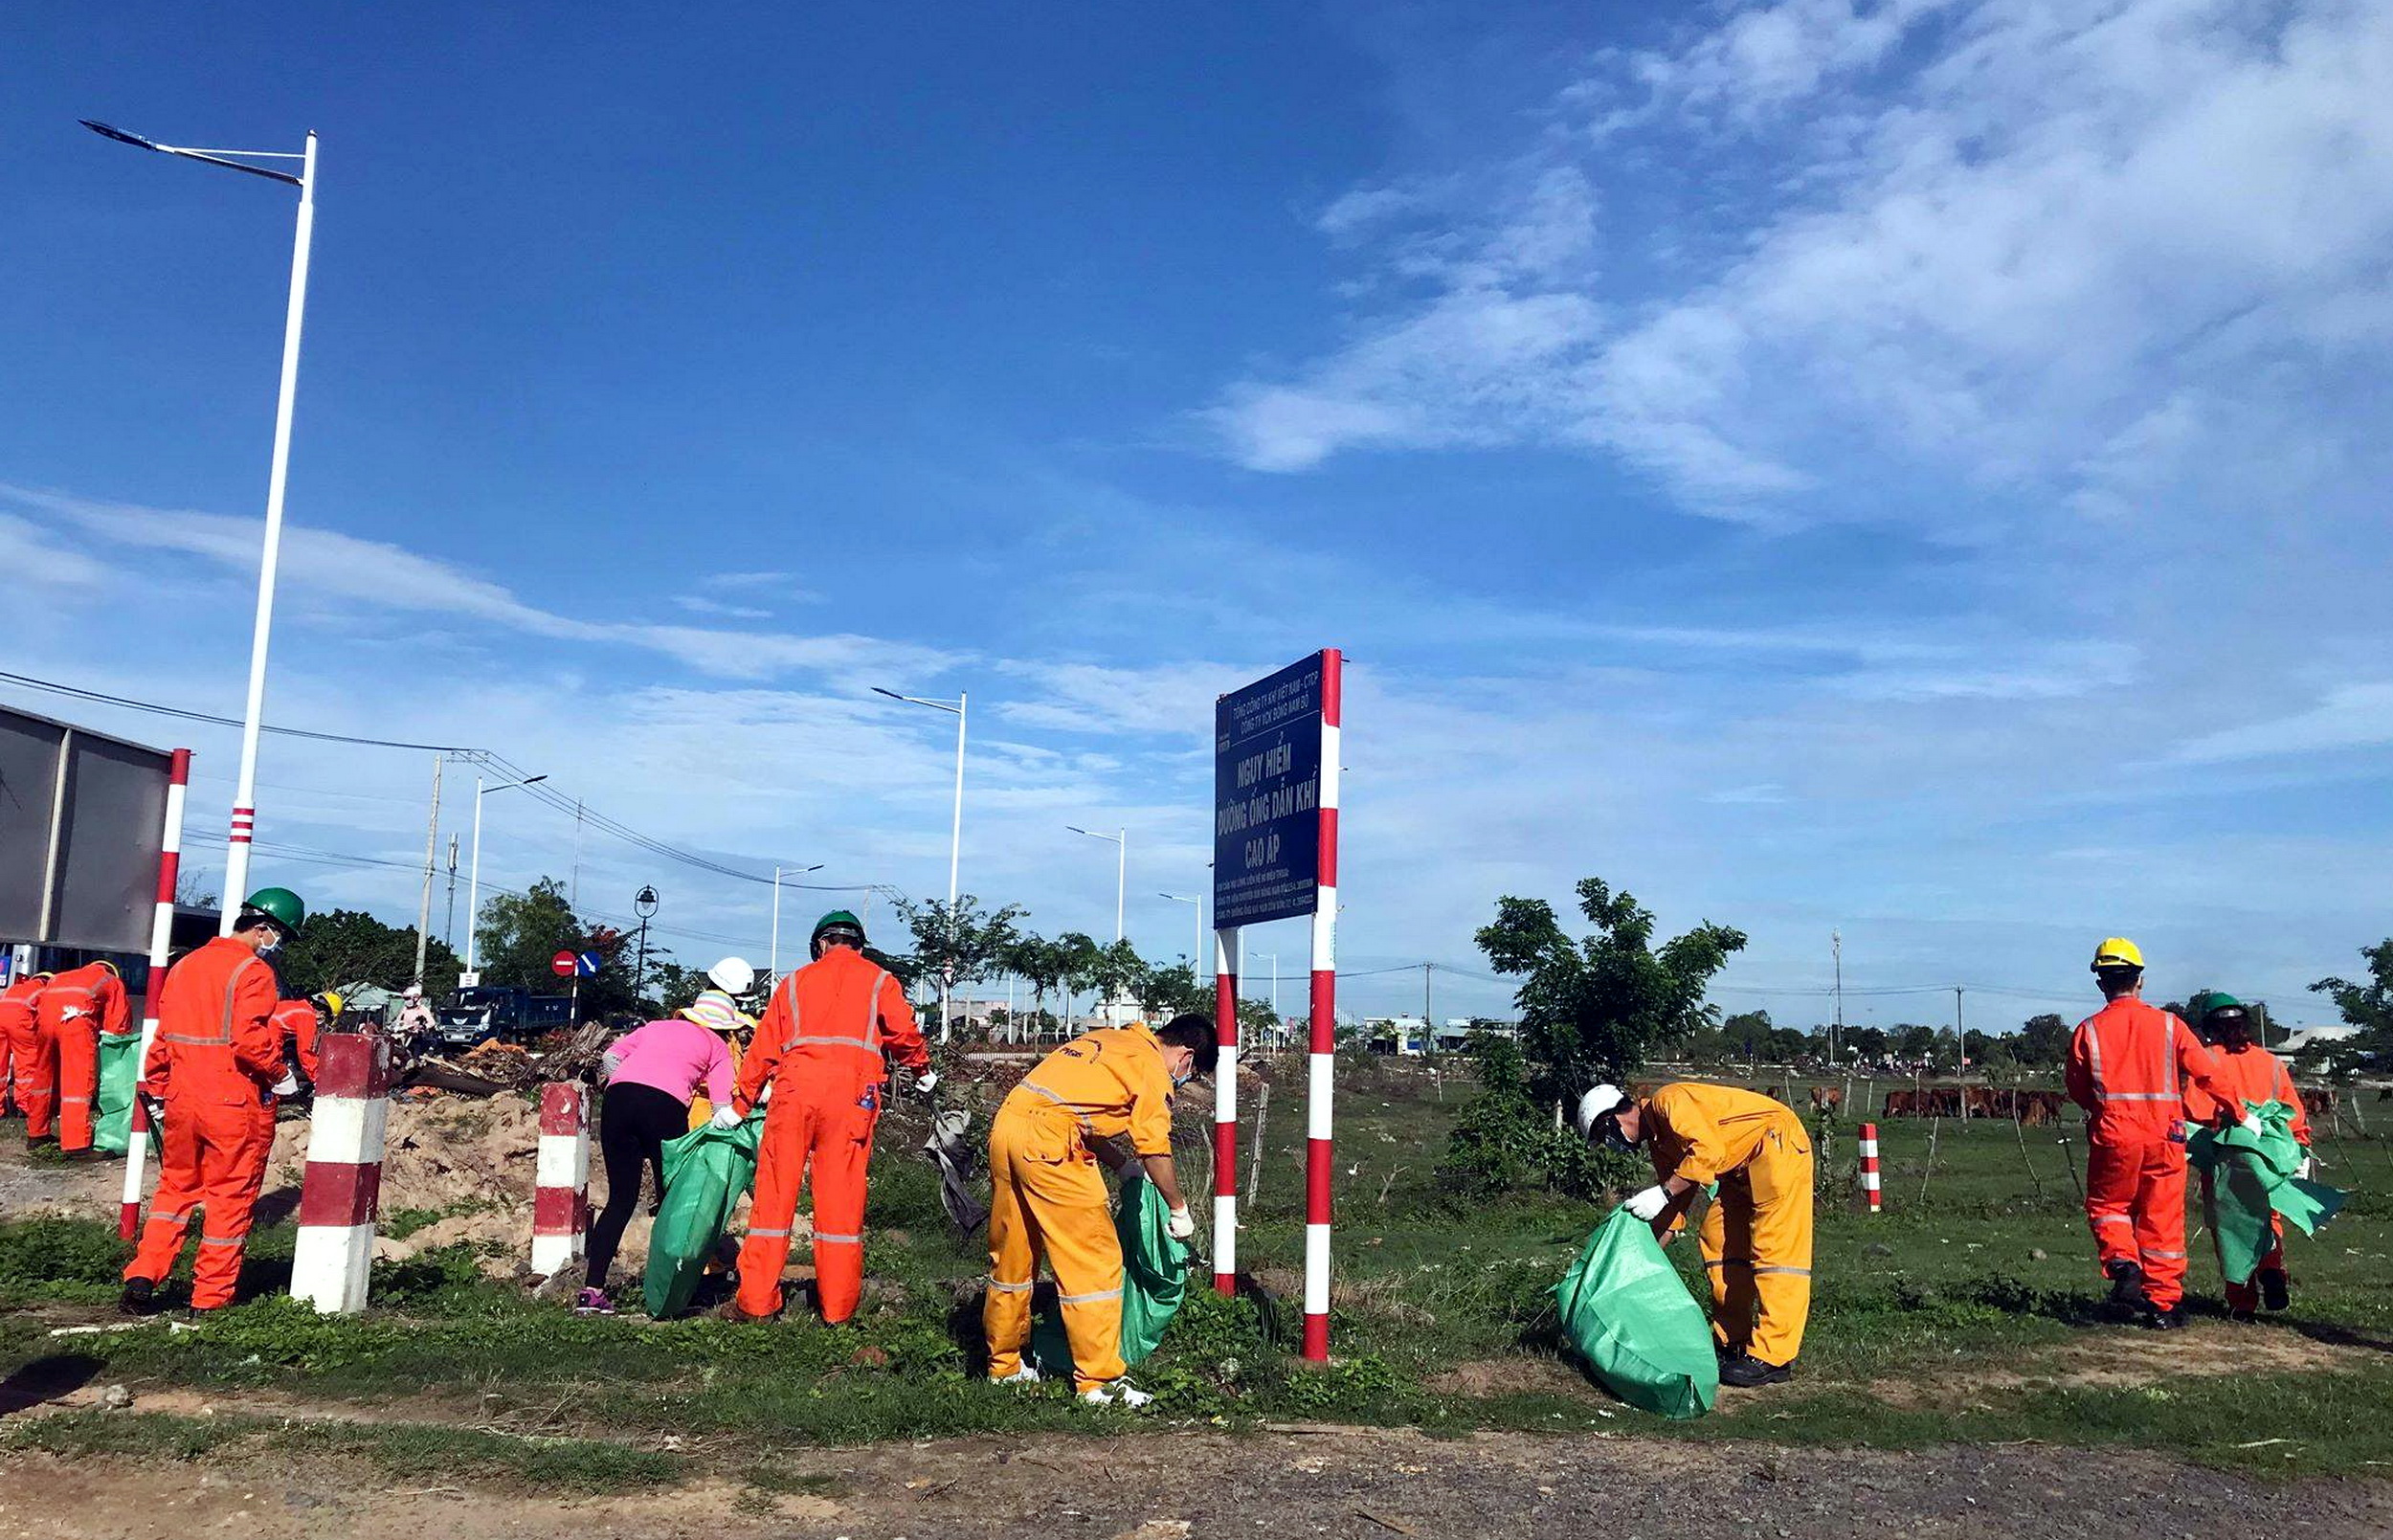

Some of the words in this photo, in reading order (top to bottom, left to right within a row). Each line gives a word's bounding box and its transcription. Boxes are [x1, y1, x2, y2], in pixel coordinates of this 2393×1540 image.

[1238, 753, 1263, 788] NGUY
[1266, 731, 1291, 777] HIỂM
[1249, 787, 1269, 826] ỐNG
[1245, 837, 1264, 868] CAO
[1266, 828, 1280, 863] ÁP
